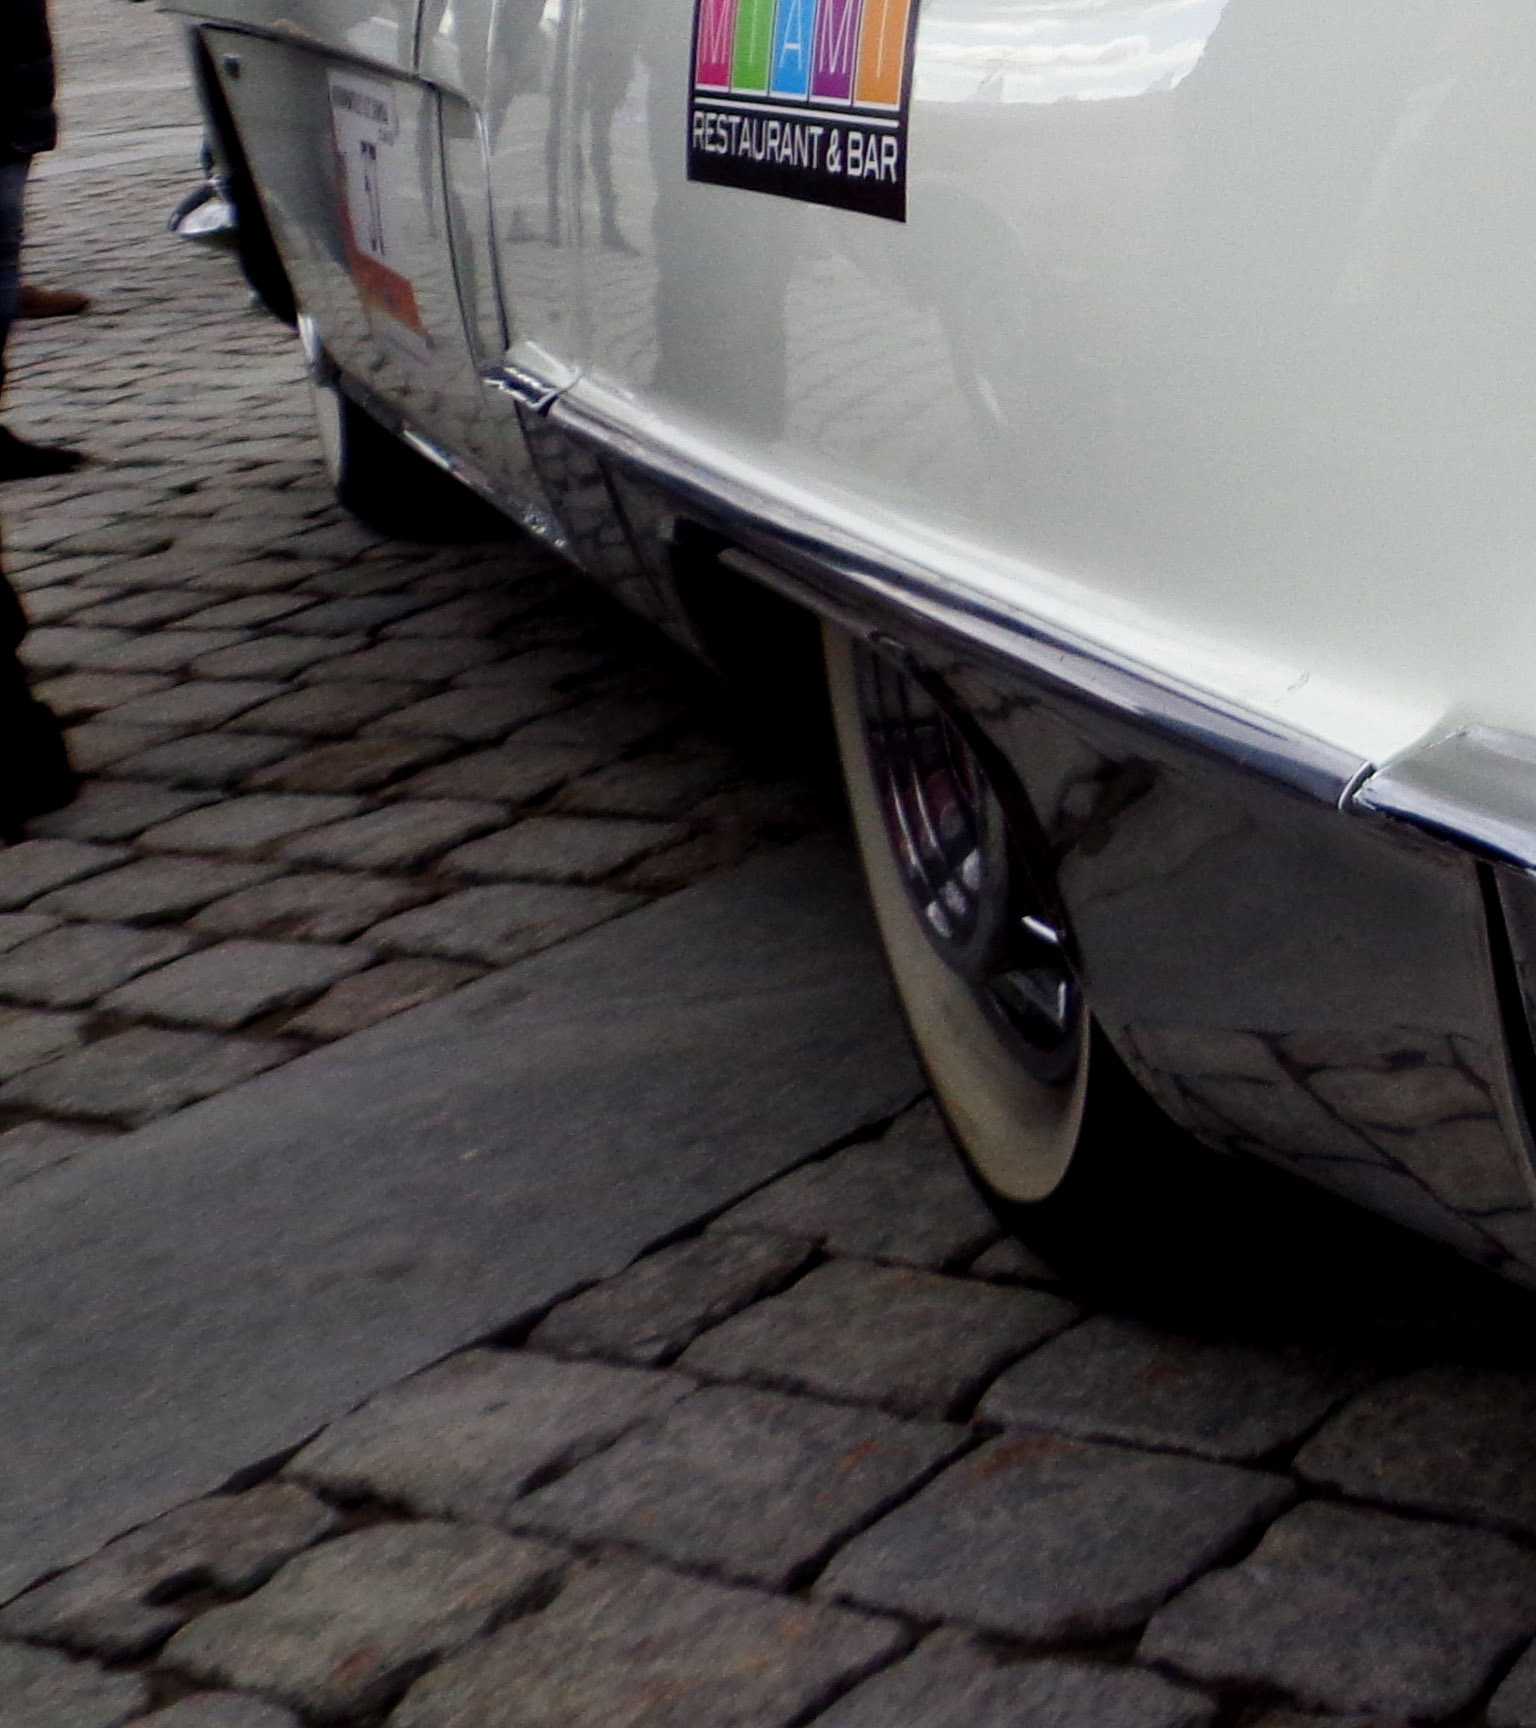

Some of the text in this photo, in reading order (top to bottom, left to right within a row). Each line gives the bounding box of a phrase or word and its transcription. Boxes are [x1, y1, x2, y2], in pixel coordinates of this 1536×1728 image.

[692, 110, 899, 184] RESTAURANT & BAR
